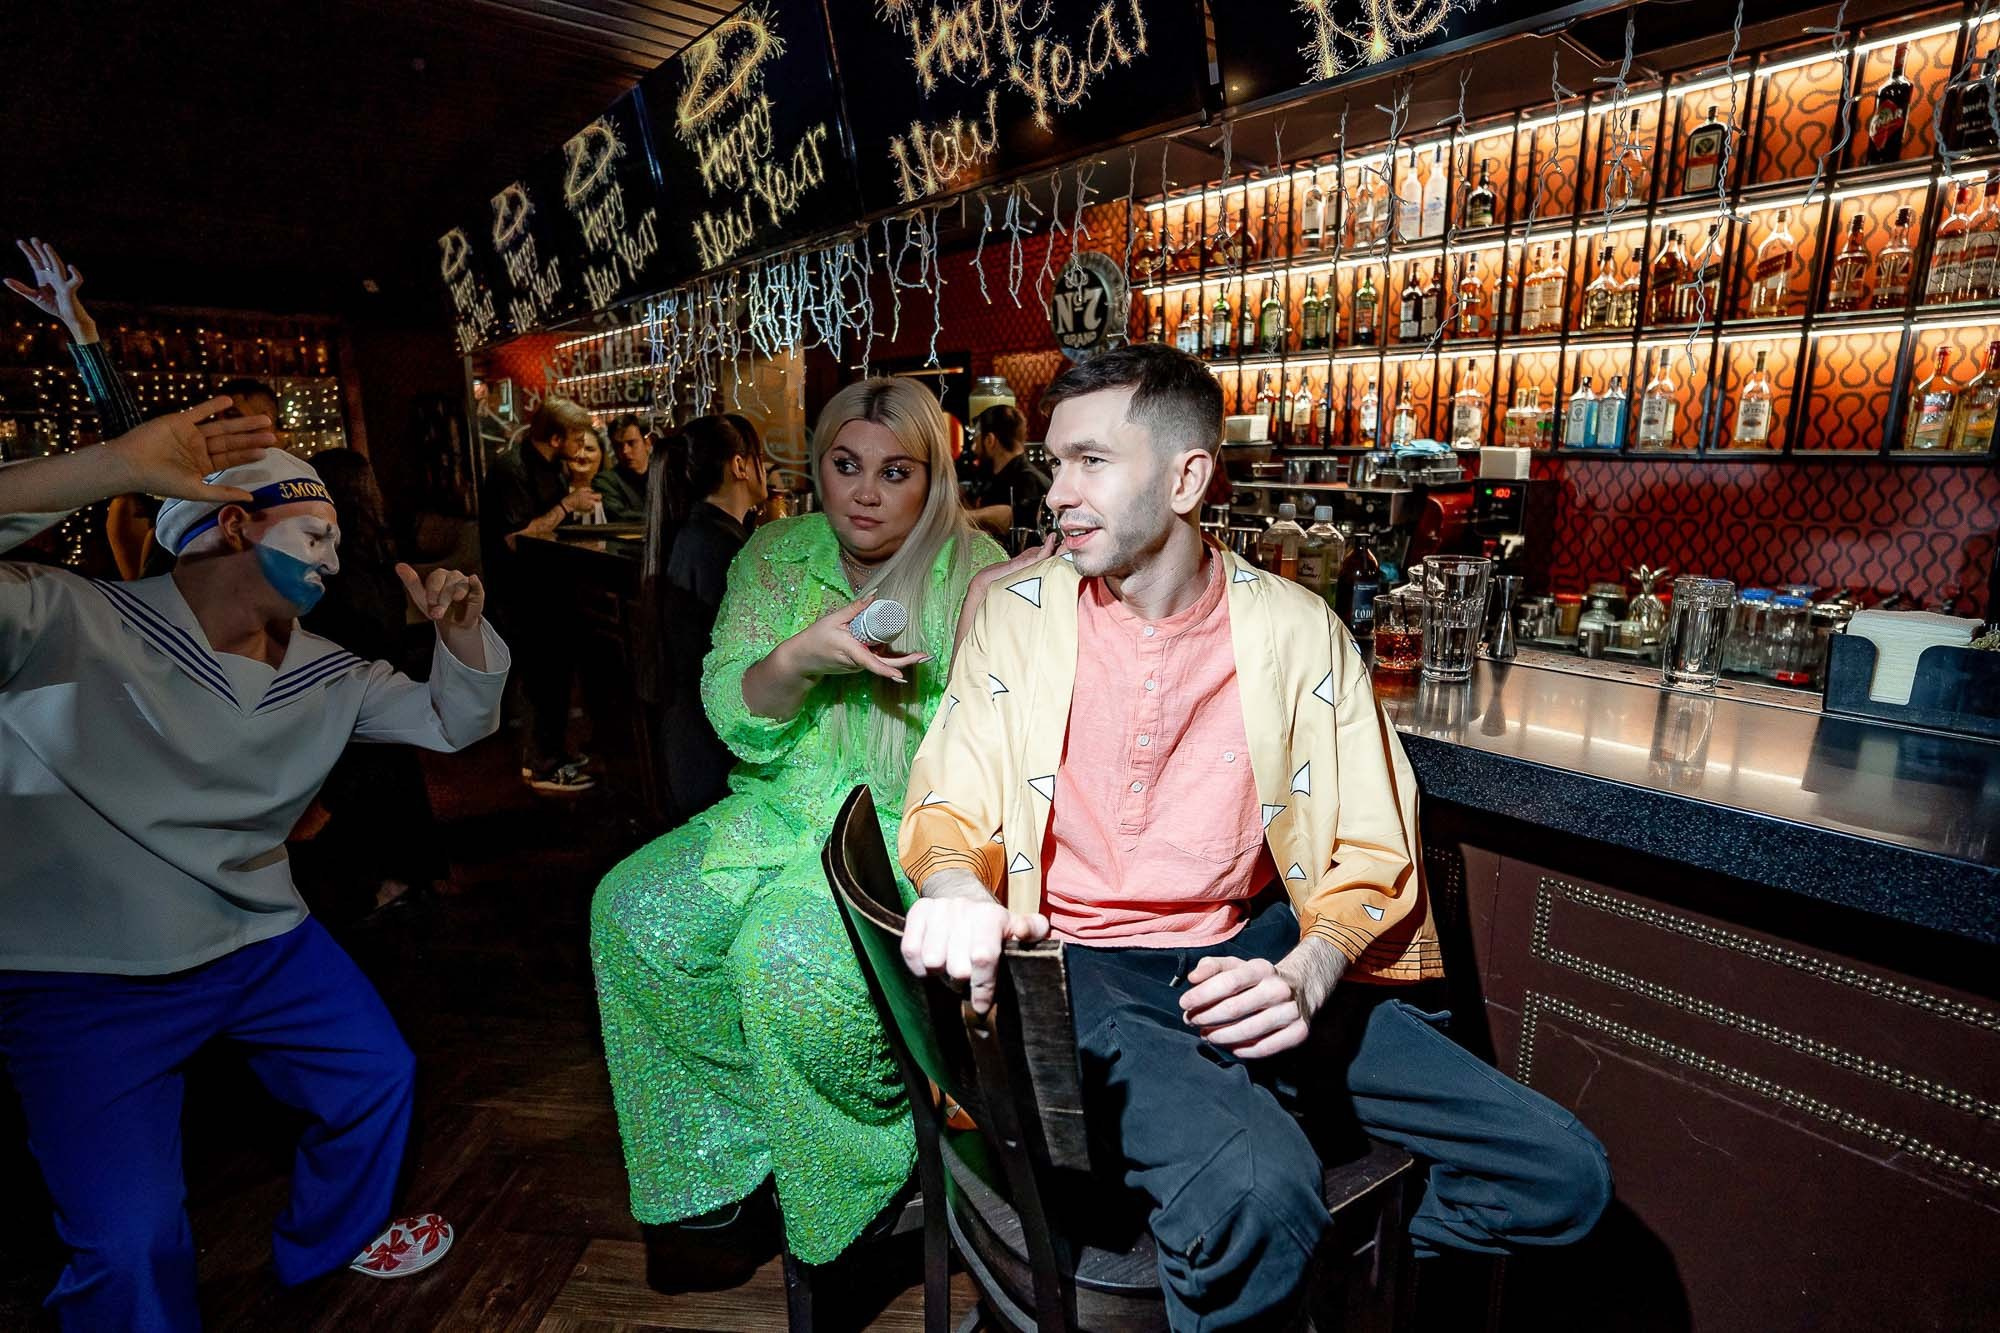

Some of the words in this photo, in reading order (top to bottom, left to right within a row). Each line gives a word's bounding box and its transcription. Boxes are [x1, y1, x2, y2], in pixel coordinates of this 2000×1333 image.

[697, 95, 772, 194] Happy
[892, 90, 1000, 202] New
[578, 181, 625, 252] Happy
[693, 196, 753, 269] New
[753, 122, 826, 226] Year
[504, 233, 538, 288] Happy
[533, 255, 561, 312] Year
[582, 256, 621, 311] New
[617, 206, 658, 281] Year
[1063, 331, 1097, 349] BRAND
